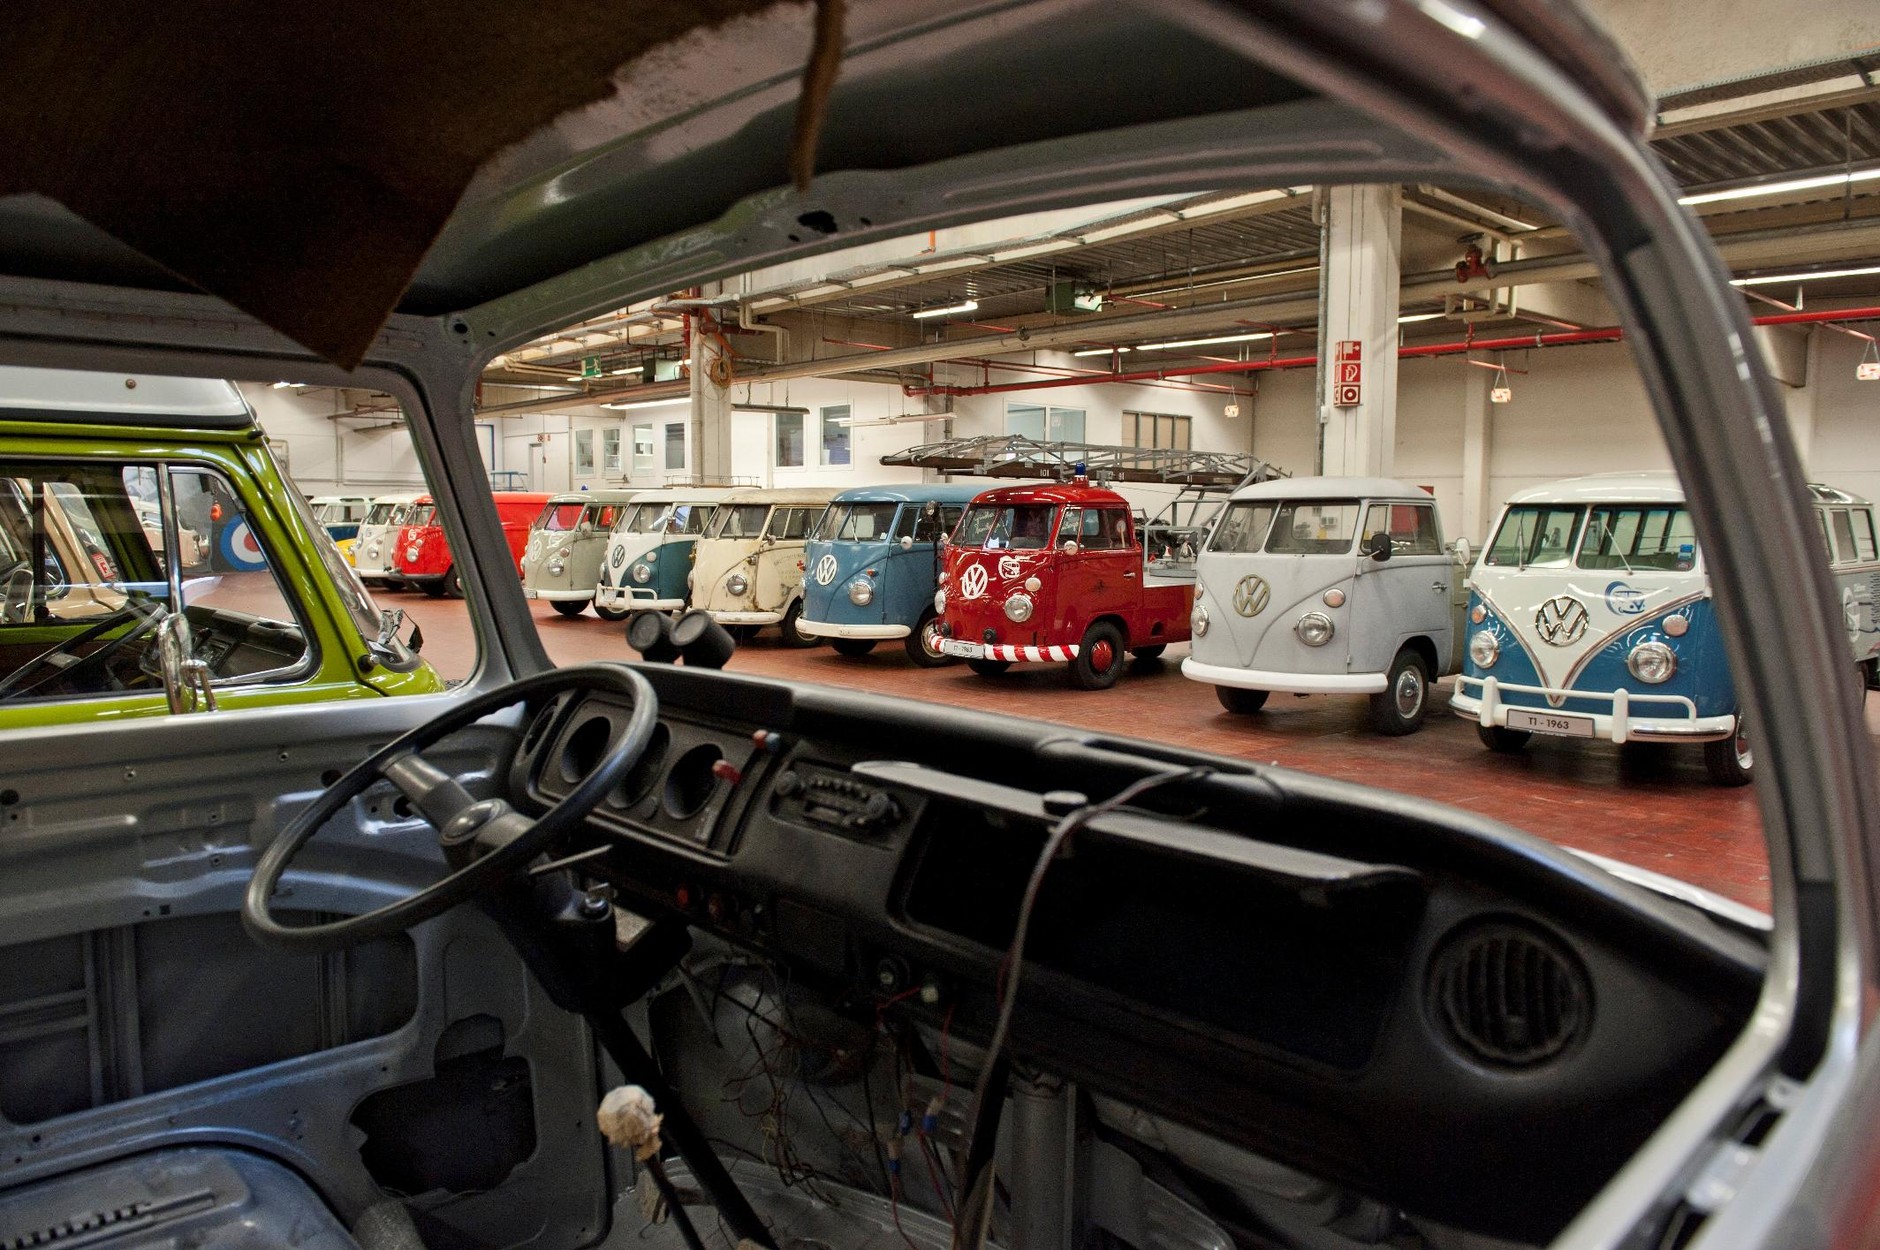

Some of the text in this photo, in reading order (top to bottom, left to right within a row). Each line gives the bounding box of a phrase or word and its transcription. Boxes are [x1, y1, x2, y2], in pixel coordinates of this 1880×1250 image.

[612, 544, 625, 568] VW
[817, 555, 837, 585] VW
[962, 564, 988, 599] VW
[1232, 574, 1271, 617] VW
[1535, 596, 1588, 647] VW
[1547, 719, 1570, 729] 1963
